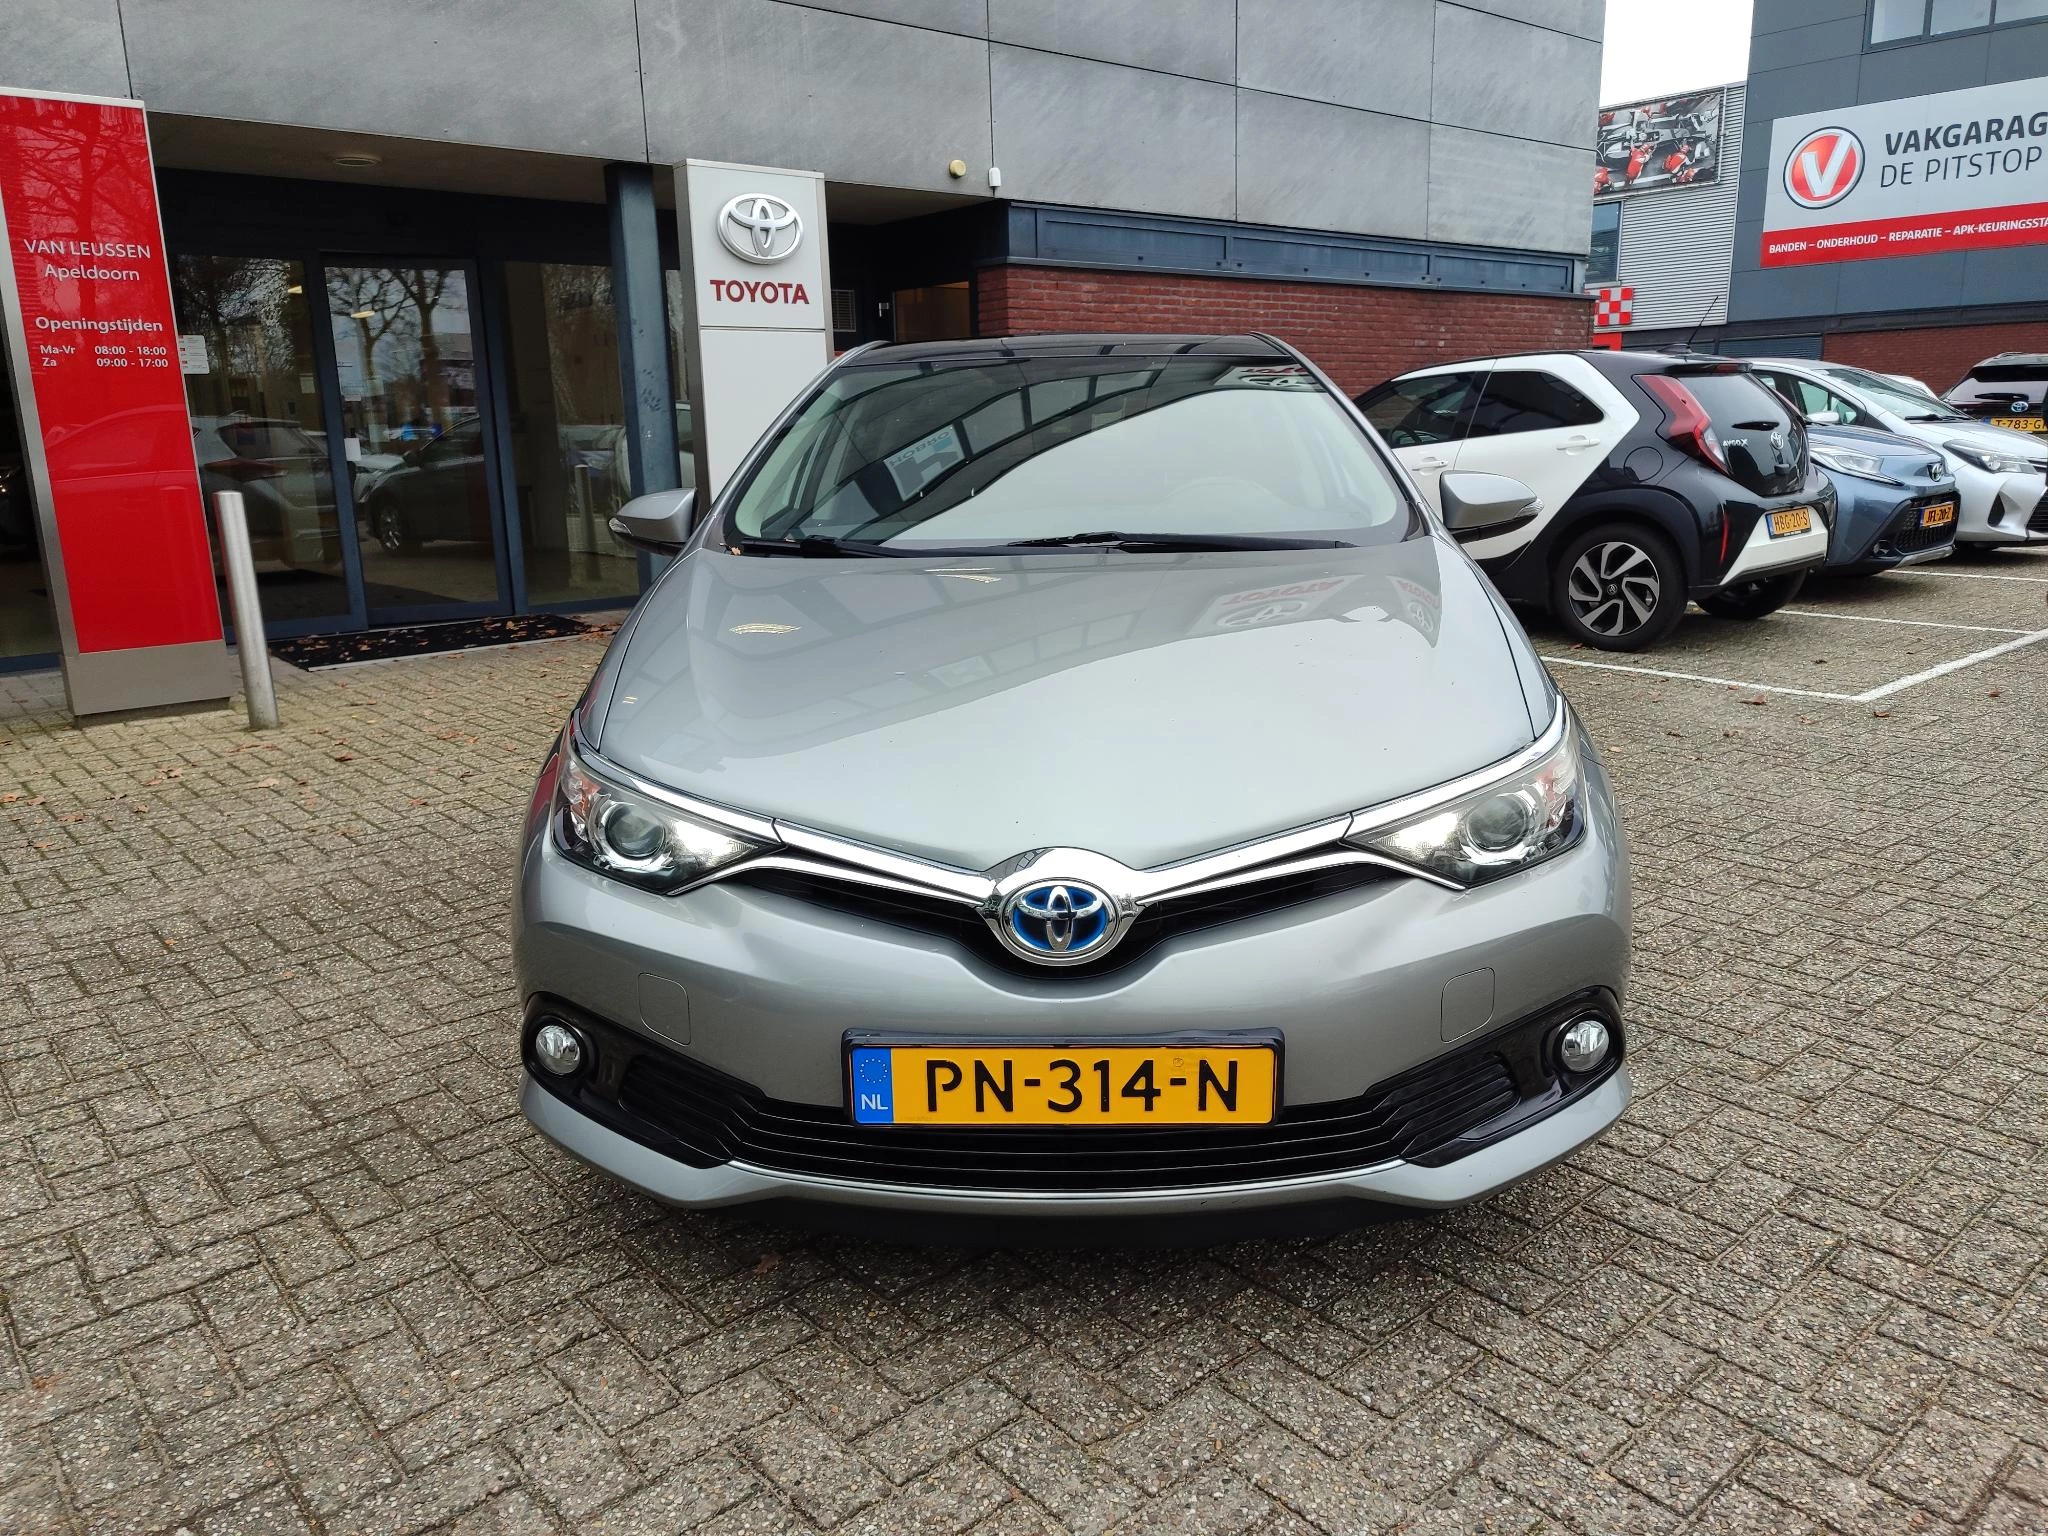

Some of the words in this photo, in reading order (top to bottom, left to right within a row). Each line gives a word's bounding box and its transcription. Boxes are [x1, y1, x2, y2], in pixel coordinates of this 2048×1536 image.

[1885, 111, 2048, 156] VAKGARAG
[1880, 161, 1914, 188] DE
[1925, 146, 2043, 182] PITSTOP
[23, 239, 65, 254] VAN
[69, 241, 151, 259] LEUSSEN
[1769, 241, 1807, 254] BANDEN
[1816, 234, 1879, 249] ONDERHOUD
[1889, 227, 1943, 242] REPARATIE
[44, 264, 140, 282] Apeldoorn
[709, 279, 810, 305] TOYOTA
[35, 316, 163, 335] Openingstijden
[40, 345, 76, 355] Ma-Vr
[94, 346, 126, 356] 08:00
[136, 346, 167, 356] 18:00
[42, 358, 58, 367] Za
[96, 358, 128, 368] 09:00
[138, 358, 169, 368] 17:00
[860, 1093, 889, 1111] NL
[925, 1058, 1238, 1113] PN-314-N
